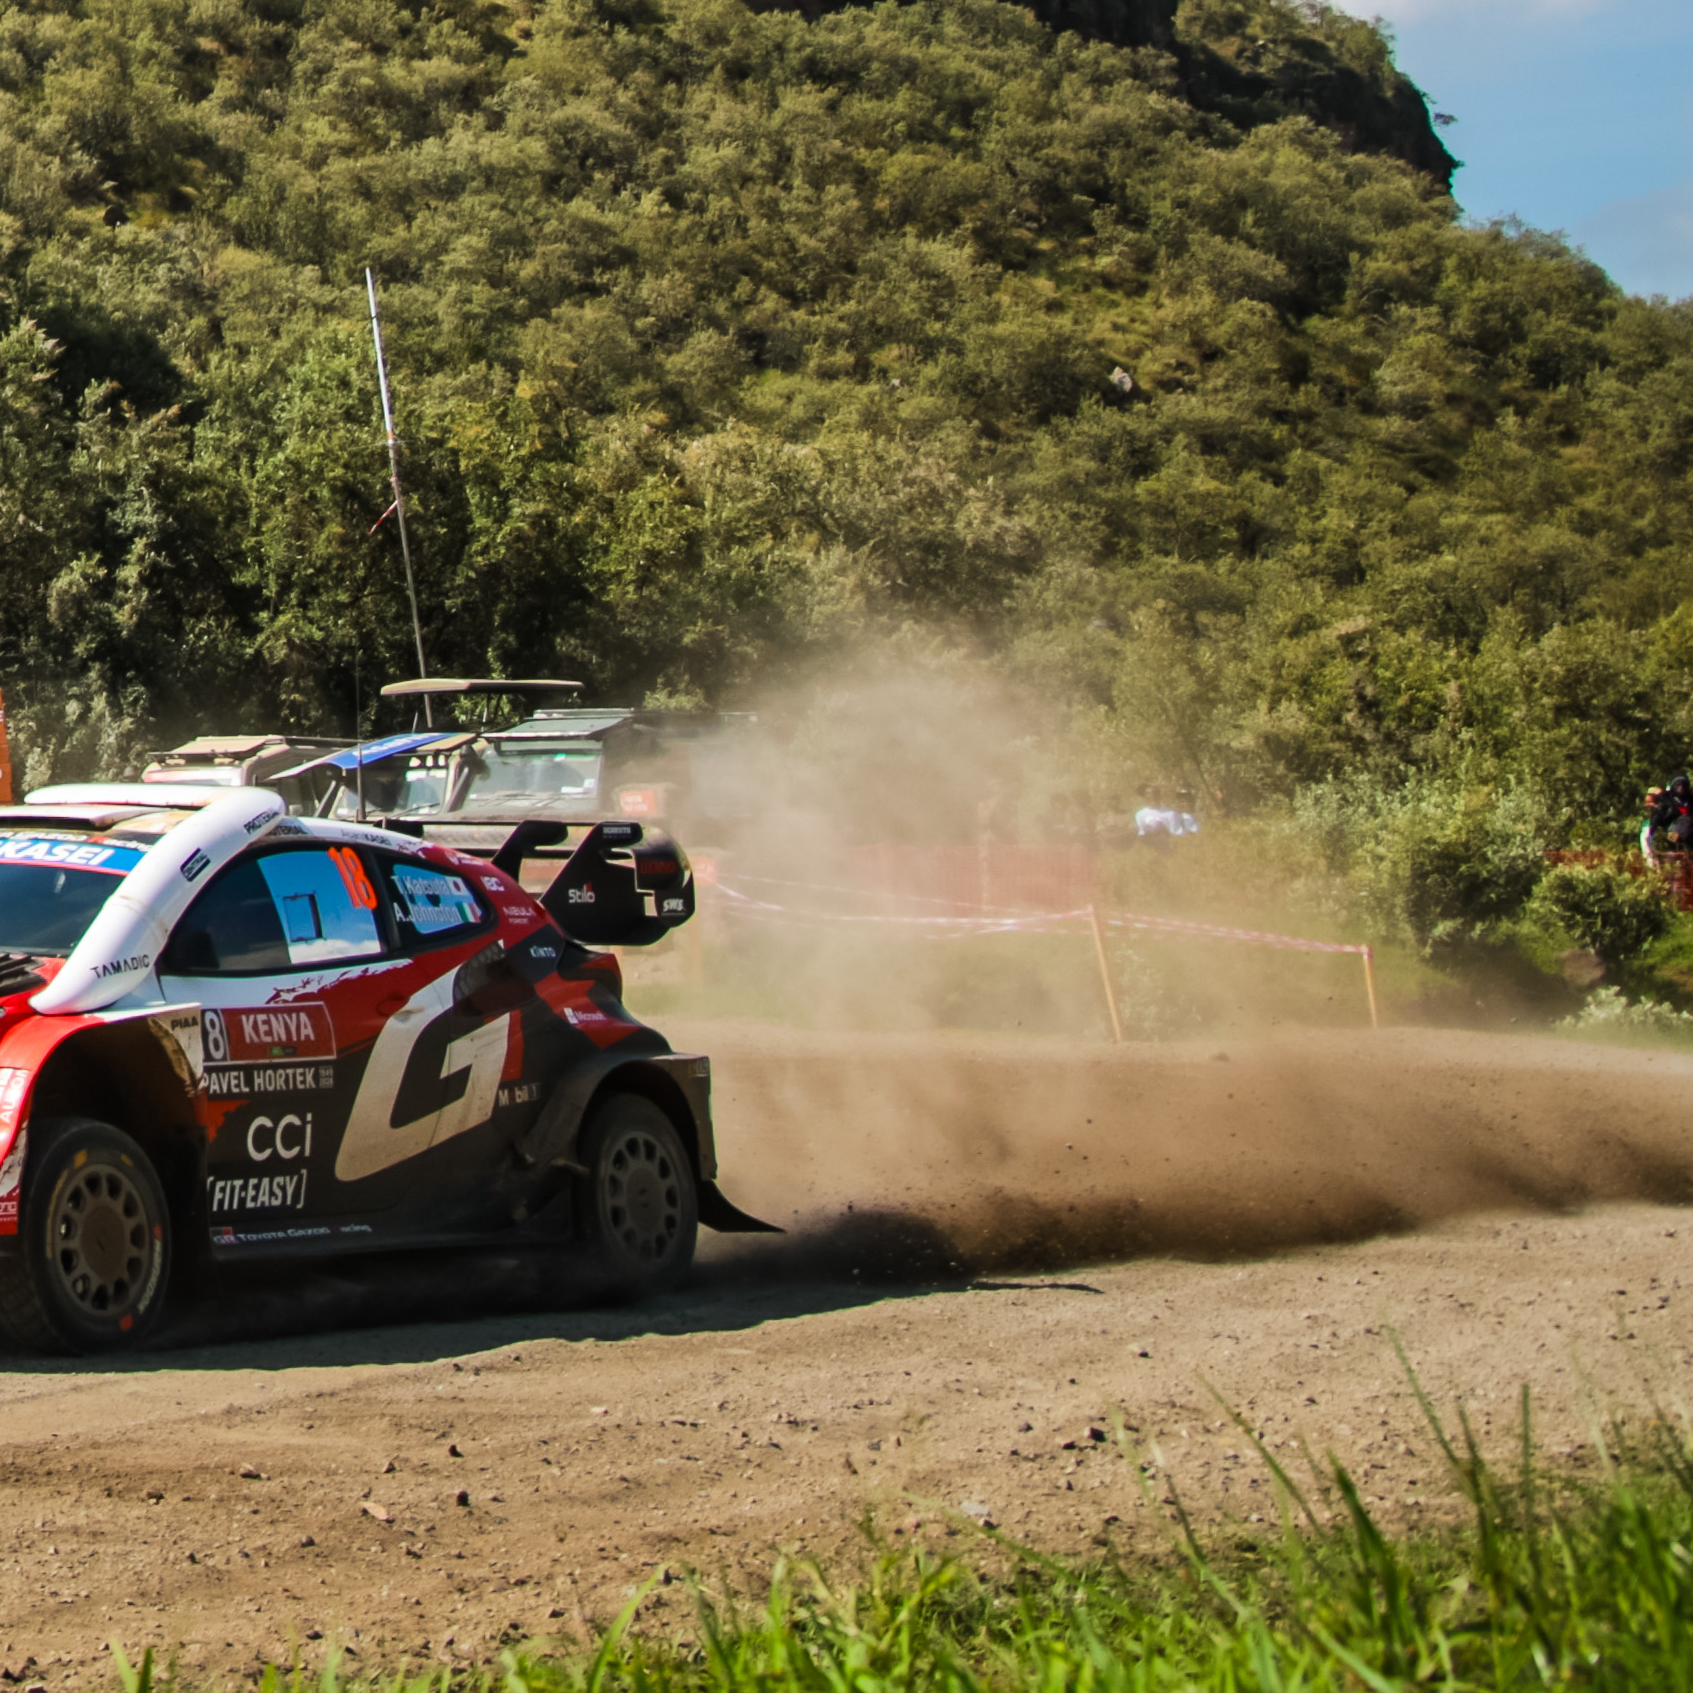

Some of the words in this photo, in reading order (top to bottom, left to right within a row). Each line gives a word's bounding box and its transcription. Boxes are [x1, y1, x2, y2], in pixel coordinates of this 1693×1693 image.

[327, 846, 378, 910] 18
[568, 883, 596, 904] Stilo
[90, 954, 150, 980] TAMADIC
[171, 1016, 199, 1030] PIAA
[240, 1011, 315, 1044] KENYA
[198, 1071, 250, 1095] PAVEL
[253, 1067, 316, 1092] HORTEK
[498, 1085, 529, 1107] Mbil
[246, 1112, 313, 1162] CCi
